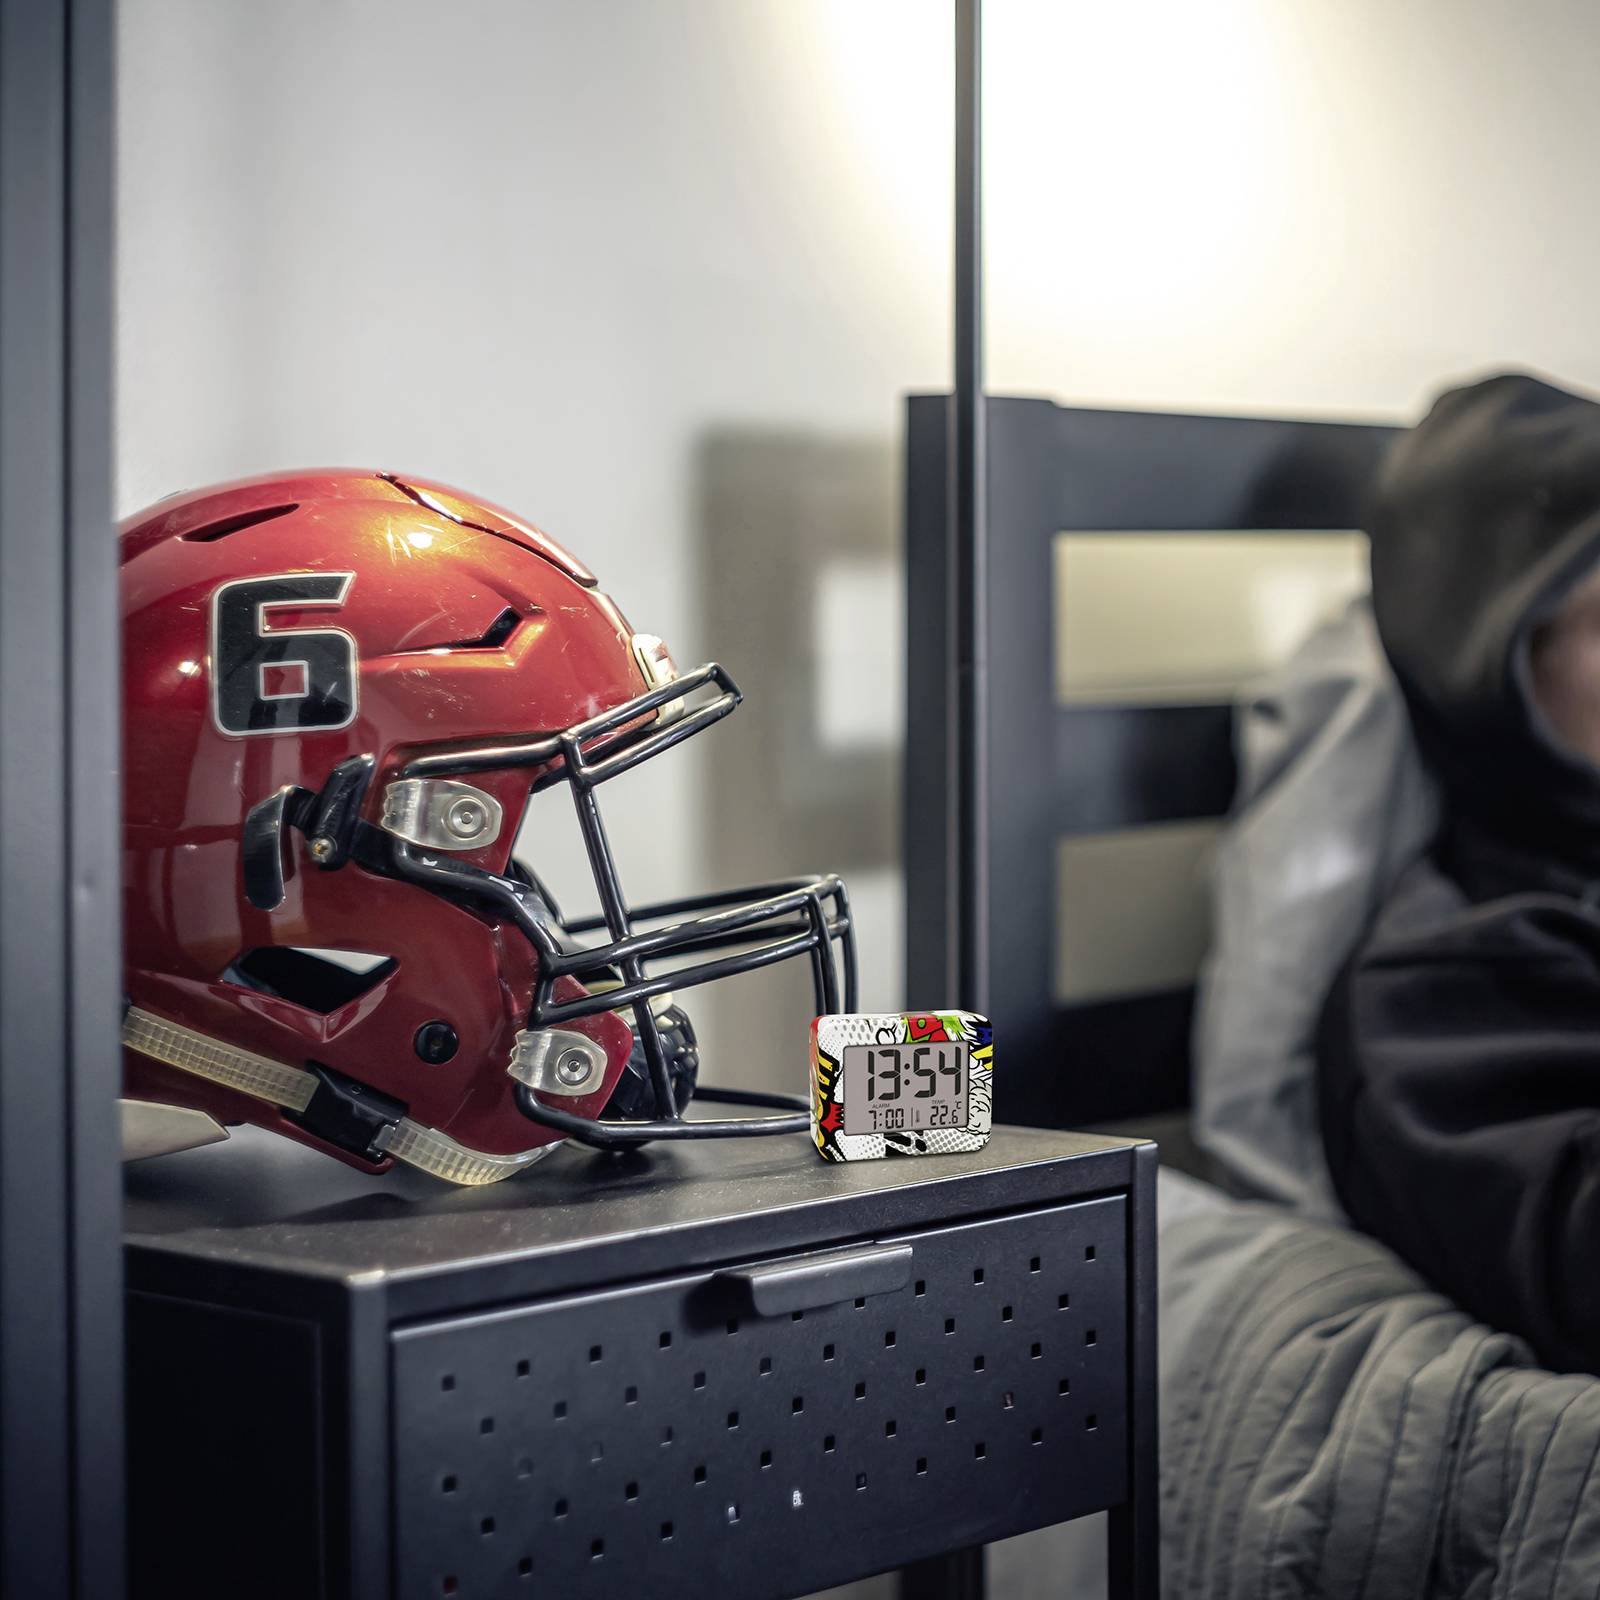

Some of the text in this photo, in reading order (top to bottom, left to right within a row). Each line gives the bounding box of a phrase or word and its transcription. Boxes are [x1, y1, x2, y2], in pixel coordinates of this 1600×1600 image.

[213, 571, 357, 737] 6
[868, 1046, 962, 1101] 13:54
[868, 1108, 904, 1130] 7:00
